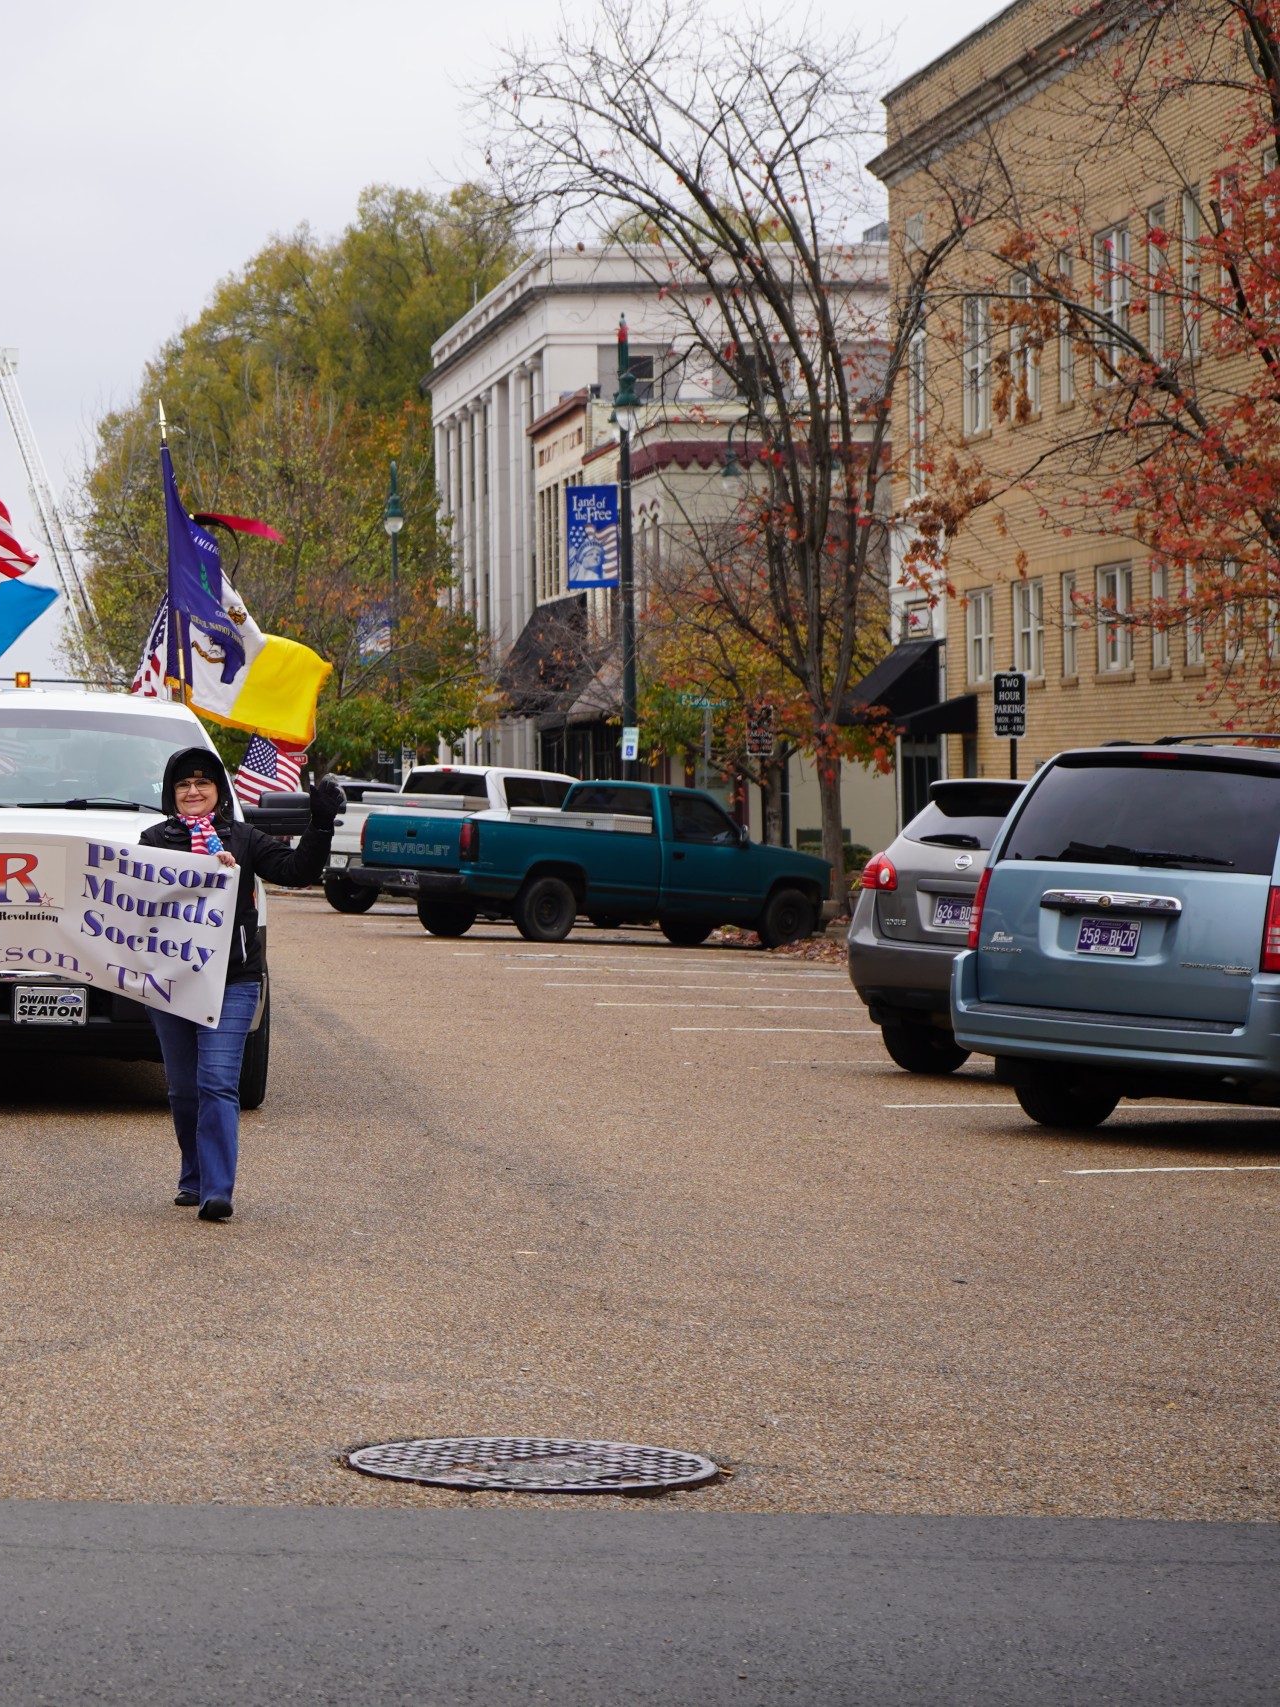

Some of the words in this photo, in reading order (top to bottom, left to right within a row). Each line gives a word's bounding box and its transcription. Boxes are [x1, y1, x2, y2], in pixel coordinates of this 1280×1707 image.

[572, 493, 596, 511] Land
[596, 496, 607, 509] of
[575, 510, 588, 520] the
[587, 506, 612, 523] Free
[1000, 678, 1019, 688] TWO
[999, 691, 1021, 701] HOUR
[994, 704, 1025, 714] PARKING
[371, 840, 451, 856] CHEVROLET
[86, 842, 229, 890] Pinson
[81, 873, 224, 928] Mounds
[936, 904, 953, 919] 626
[81, 910, 217, 973] Society
[1080, 927, 1101, 944] 358
[1109, 929, 1137, 947] BHZR
[106, 962, 177, 1004] TN
[19, 994, 59, 1005] DWAIN
[18, 1005, 84, 1018] SEATON
